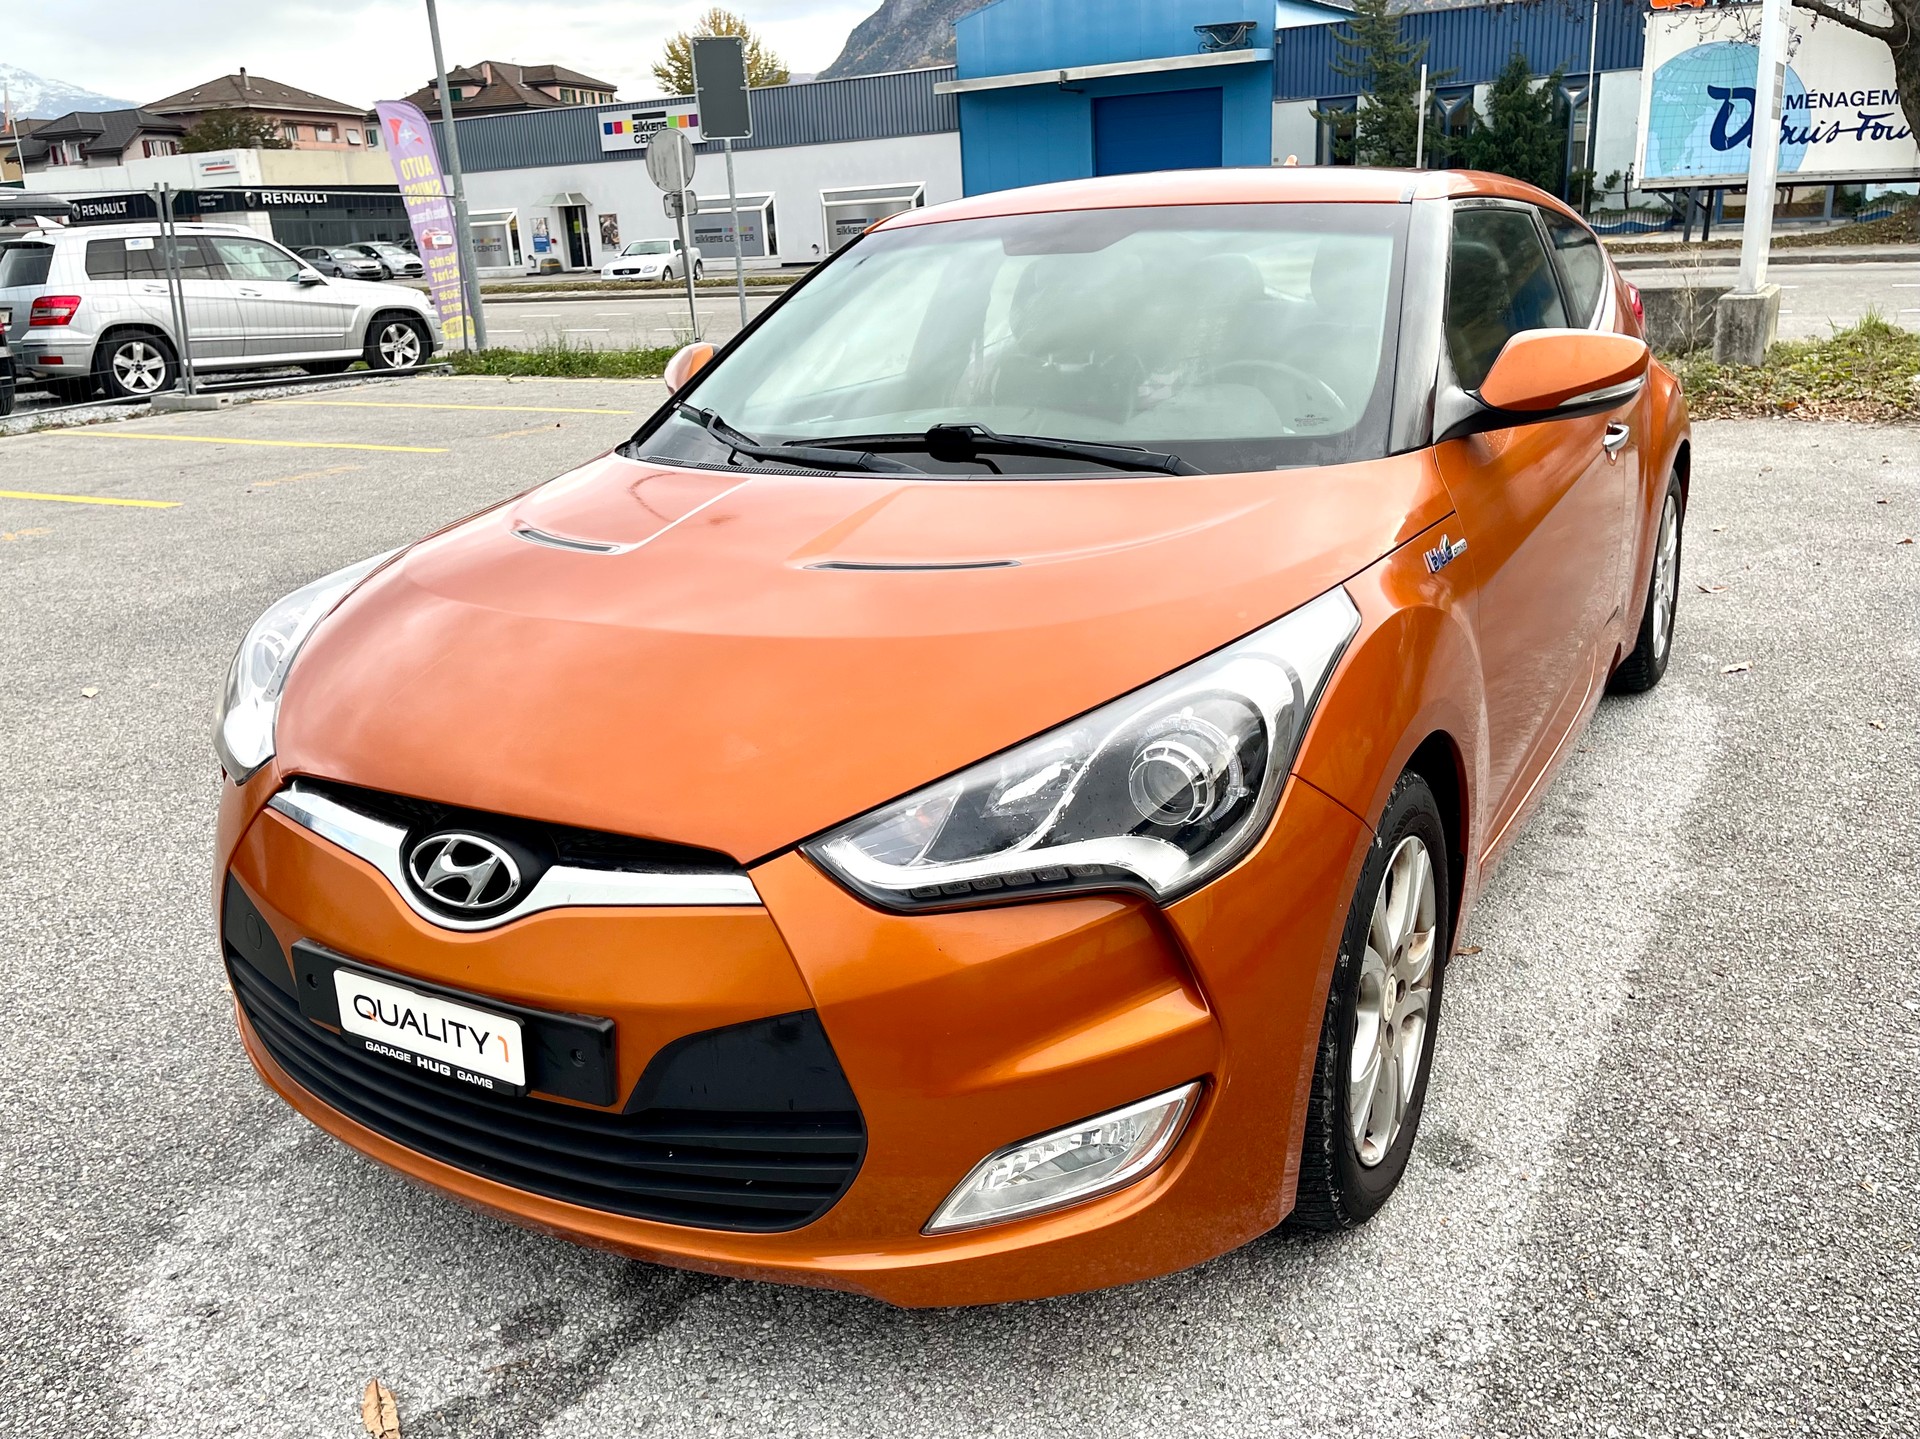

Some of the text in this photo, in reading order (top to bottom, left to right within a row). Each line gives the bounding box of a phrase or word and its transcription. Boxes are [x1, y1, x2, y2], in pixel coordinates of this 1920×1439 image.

[1781, 88, 1899, 110] MÉNAGEM
[633, 120, 667, 133] sikkens
[1707, 84, 1840, 151] Dbuis
[634, 133, 654, 144] CEN
[82, 201, 128, 217] RENAULT
[695, 233, 755, 244] sikkens CETER
[353, 994, 490, 1055] QUALITY
[365, 1040, 494, 1090] GARAGE HUG GAMS
